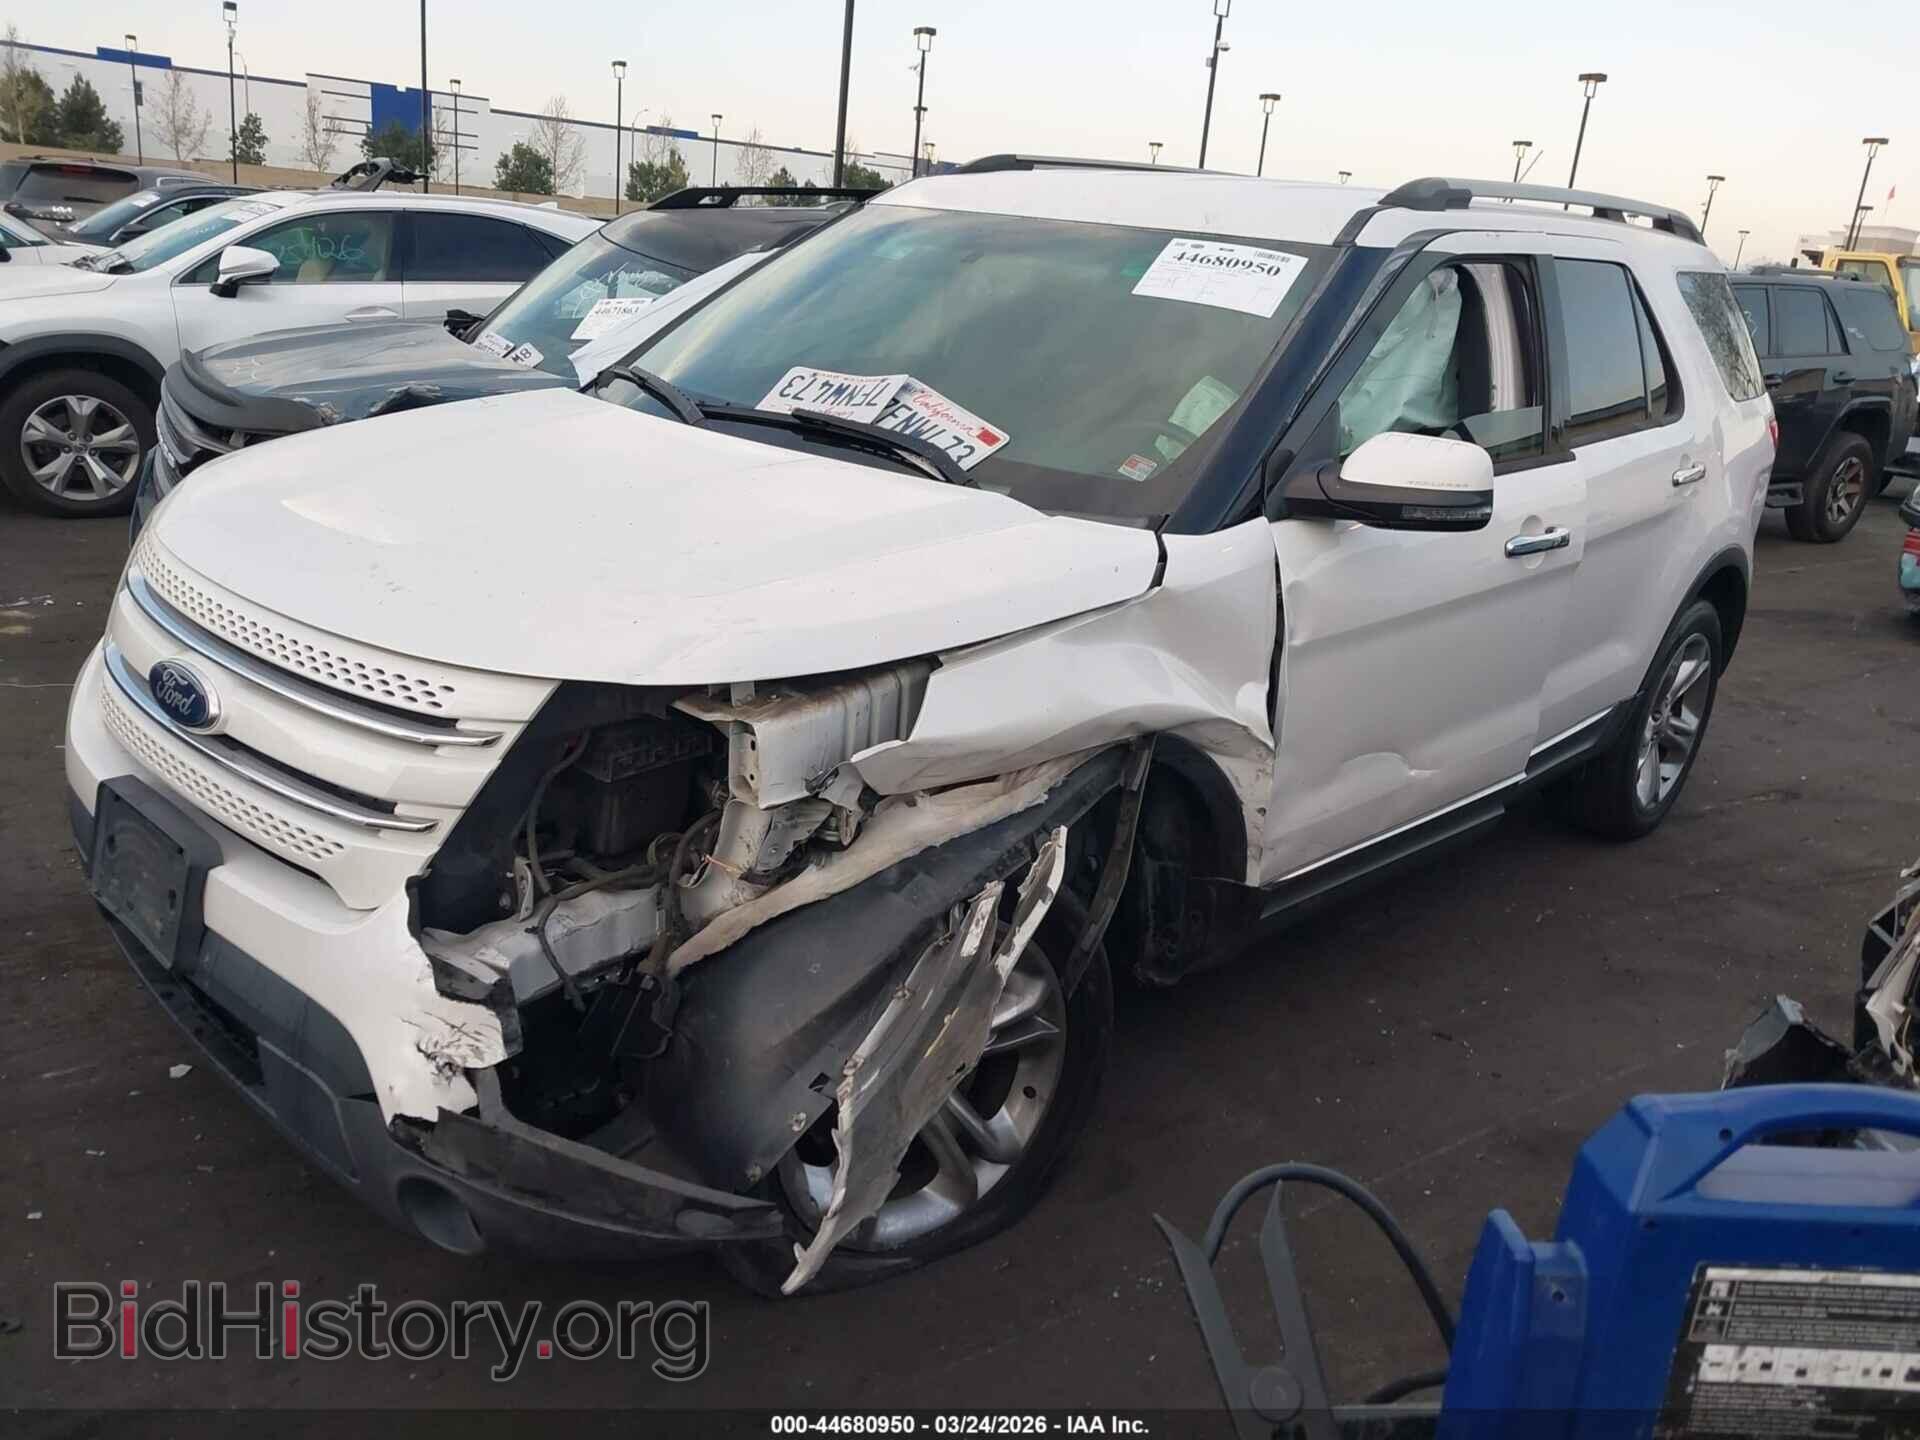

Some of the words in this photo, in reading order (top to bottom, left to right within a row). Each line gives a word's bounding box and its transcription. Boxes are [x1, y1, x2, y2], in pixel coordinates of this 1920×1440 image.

[1173, 251, 1281, 277] 44680950
[779, 375, 890, 406] 7FNW473
[912, 391, 977, 438] California
[156, 668, 196, 715] Ford
